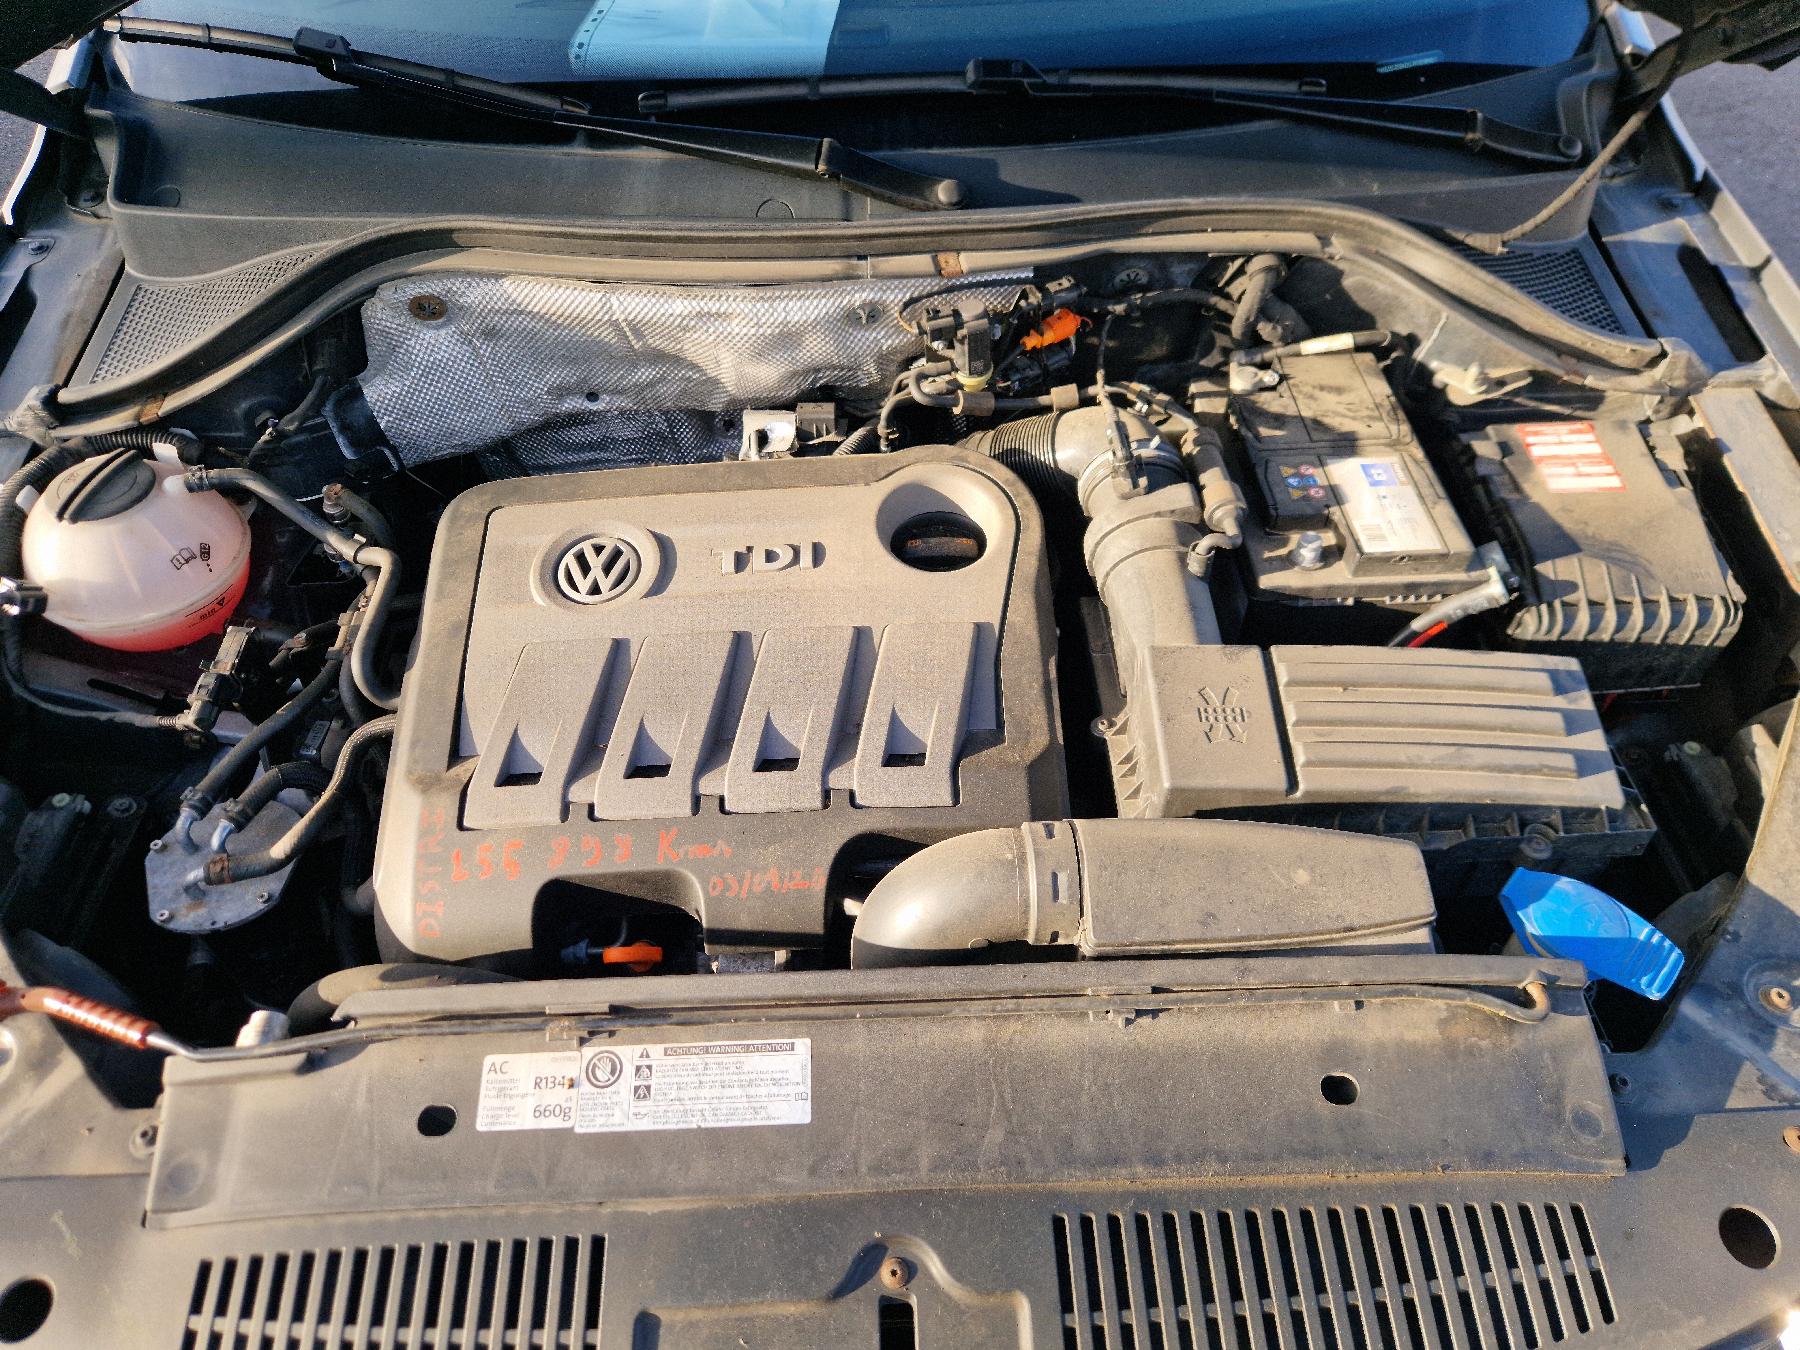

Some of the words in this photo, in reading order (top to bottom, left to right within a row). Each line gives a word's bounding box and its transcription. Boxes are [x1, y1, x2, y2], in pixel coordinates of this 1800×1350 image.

[712, 541, 819, 576] TDI
[199, 608, 216, 620] min
[666, 1047, 707, 1056] ACHTUNG!
[708, 1045, 747, 1054] WARNING!
[749, 1043, 793, 1052] ATTENTION!
[487, 1061, 509, 1075] AC
[534, 1075, 575, 1090] R134
[533, 1104, 572, 1122] 660g
